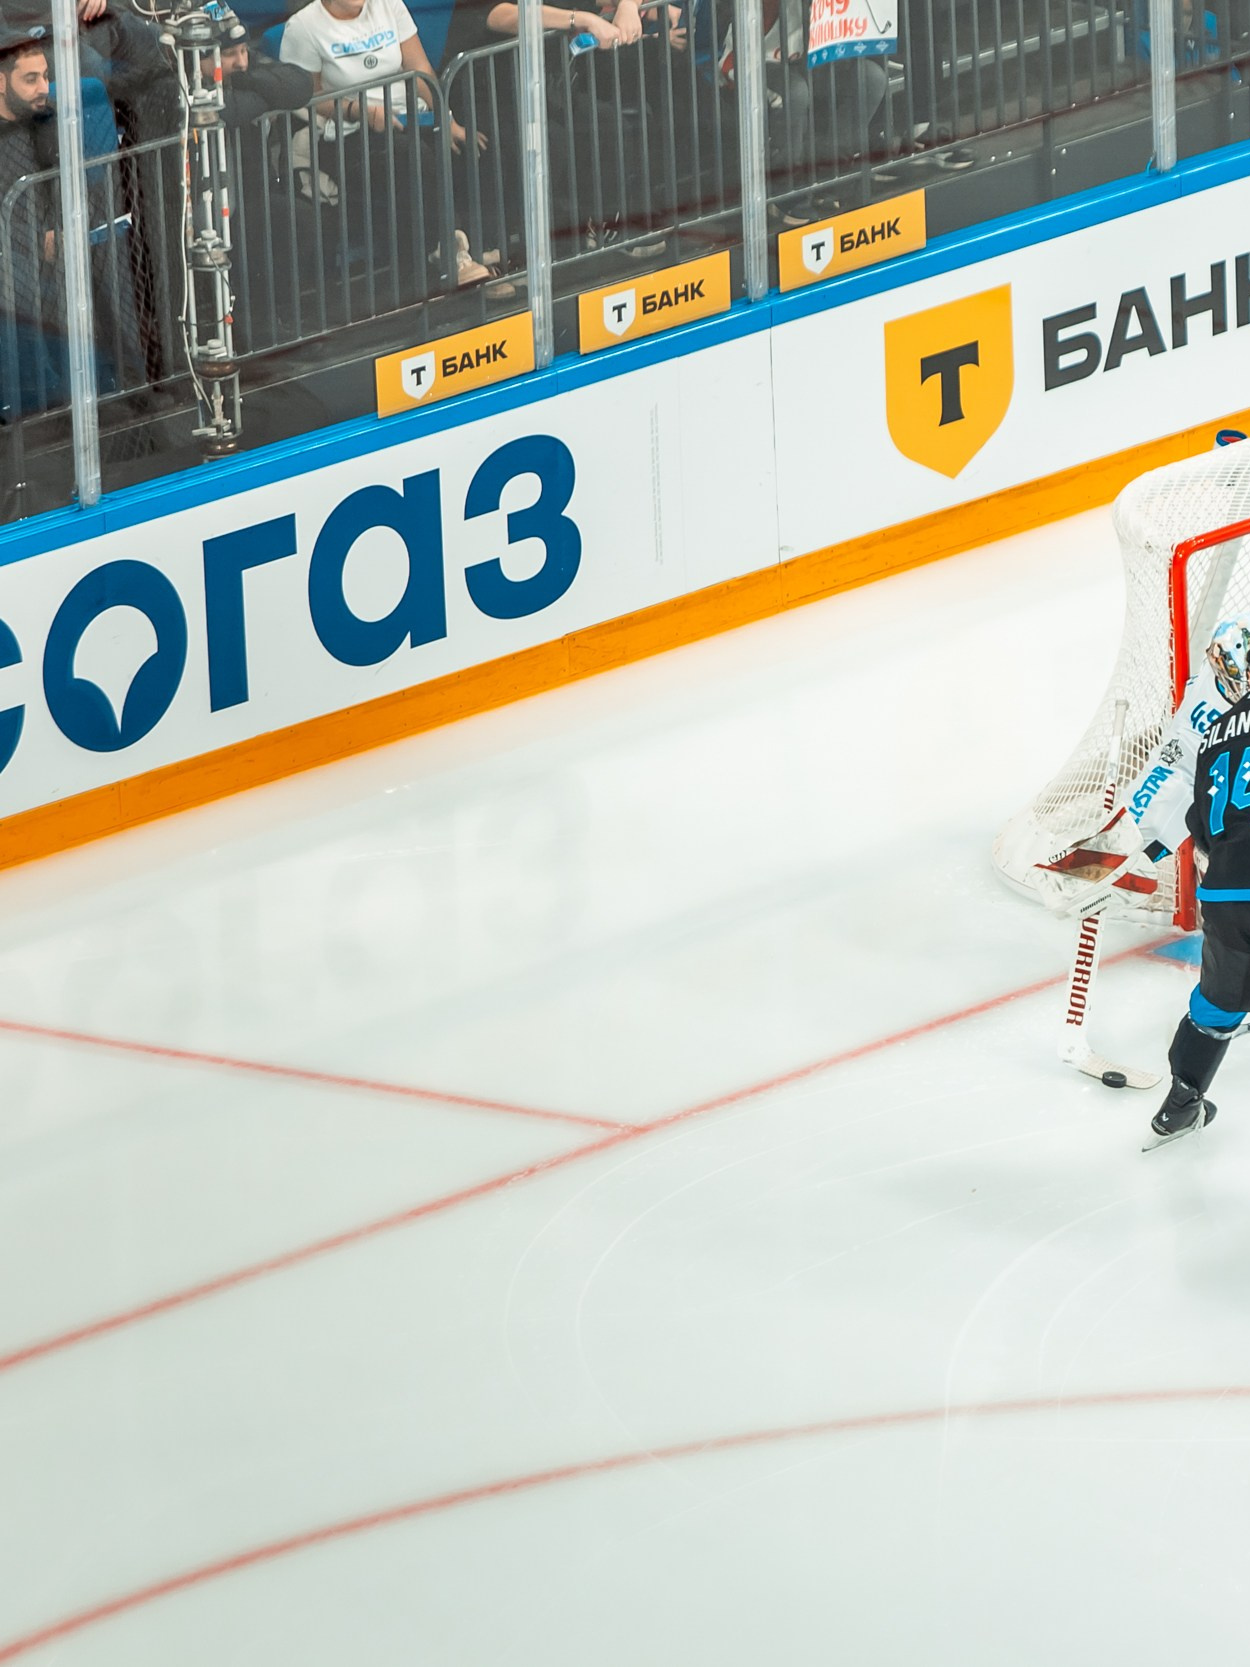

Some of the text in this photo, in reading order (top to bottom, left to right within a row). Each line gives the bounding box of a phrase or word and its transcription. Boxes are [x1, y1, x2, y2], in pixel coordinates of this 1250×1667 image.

[840, 216, 902, 255] БАНК
[641, 279, 705, 316] БАНК
[441, 339, 509, 379] БАНК
